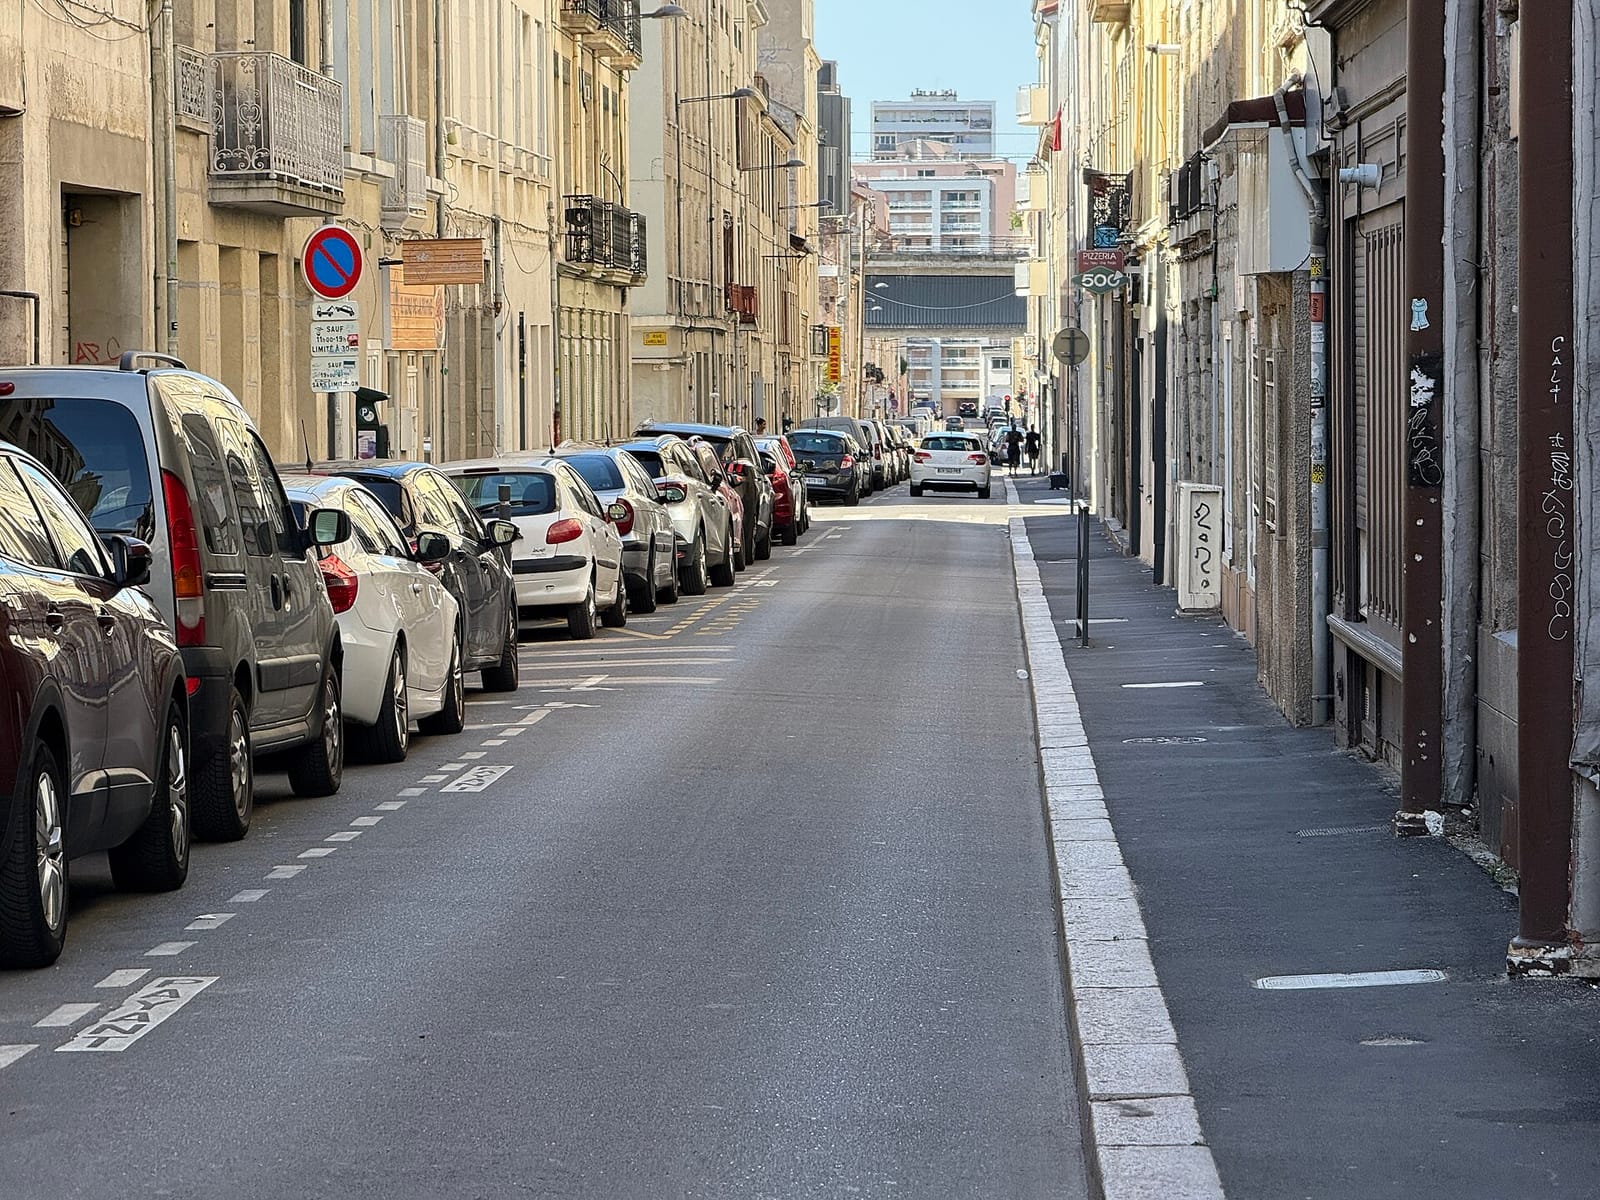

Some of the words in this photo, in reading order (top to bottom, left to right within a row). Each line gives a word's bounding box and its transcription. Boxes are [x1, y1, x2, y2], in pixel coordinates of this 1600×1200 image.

[1082, 252, 1117, 260] PIZZERIA
[1081, 273, 1120, 287] 500
[326, 325, 344, 333] SAUF
[82, 977, 205, 1049] PAYANT
